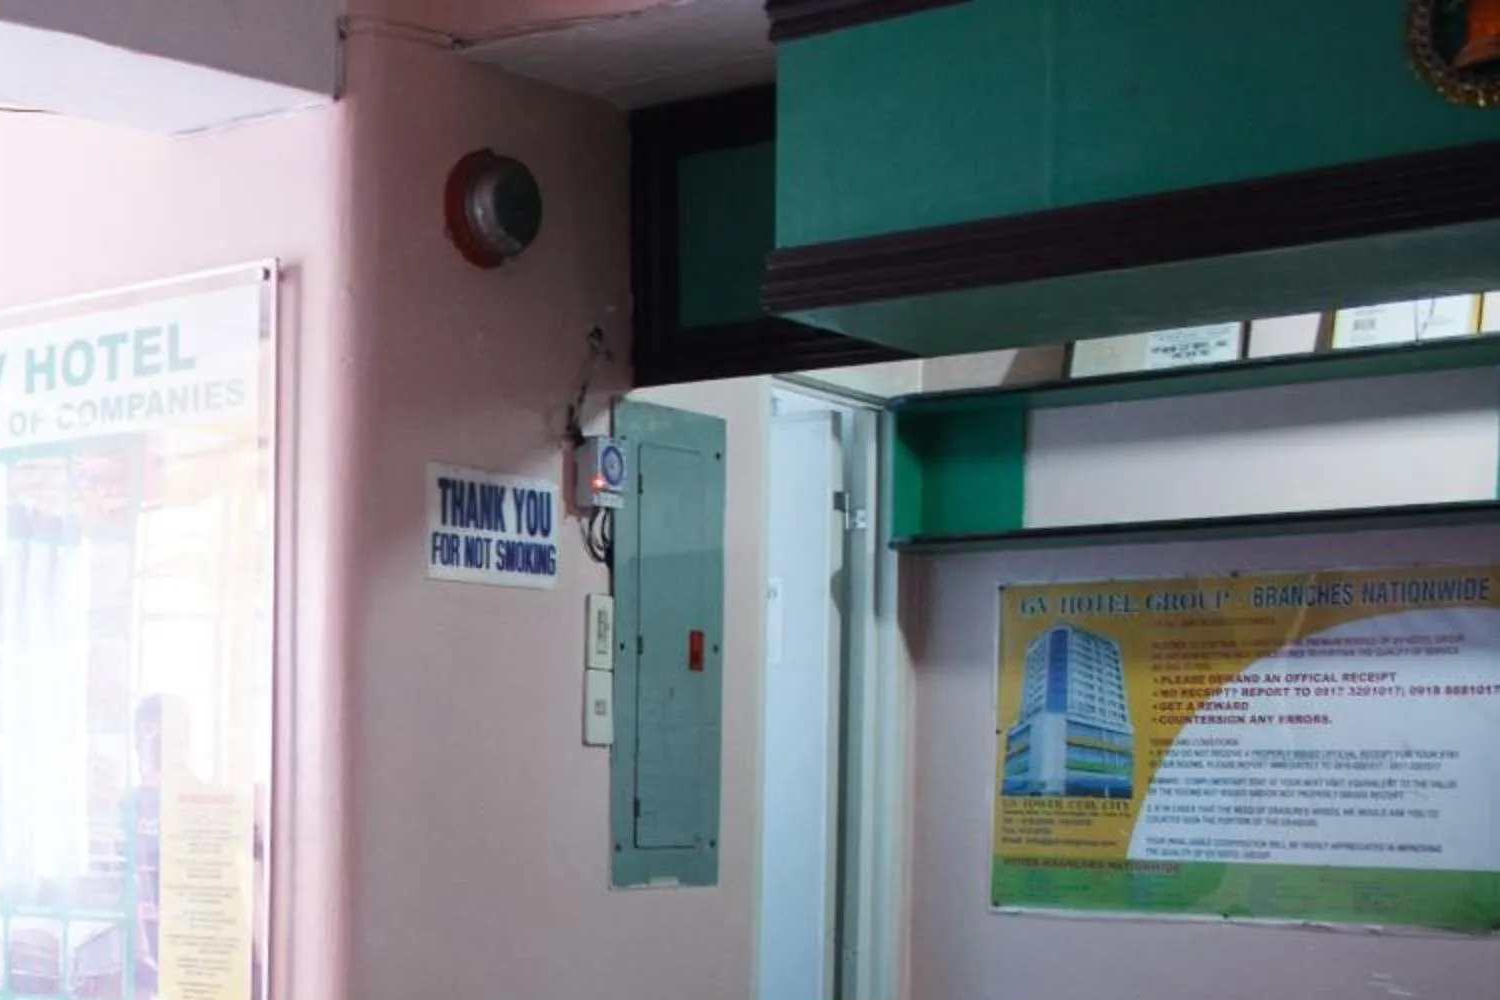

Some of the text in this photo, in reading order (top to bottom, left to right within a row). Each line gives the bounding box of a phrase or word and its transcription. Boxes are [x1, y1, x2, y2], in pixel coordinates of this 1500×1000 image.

[24, 322, 197, 395] HOTEL
[8, 410, 46, 437] OF
[56, 378, 246, 431] COMPANIES
[437, 477, 552, 537] THANK YOU
[431, 531, 556, 577] FOR NOT SMOKING
[1060, 592, 1138, 613] HOTEL
[1145, 588, 1230, 611] GROUP
[1253, 582, 1353, 608] BRANCHES
[1362, 577, 1490, 604] NATIONWIDE
[1241, 687, 1290, 697] REPORT
[1293, 687, 1312, 697] TO
[1264, 673, 1281, 683] AN
[1342, 671, 1397, 683] RECEIPT
[1250, 714, 1274, 725] ANY
